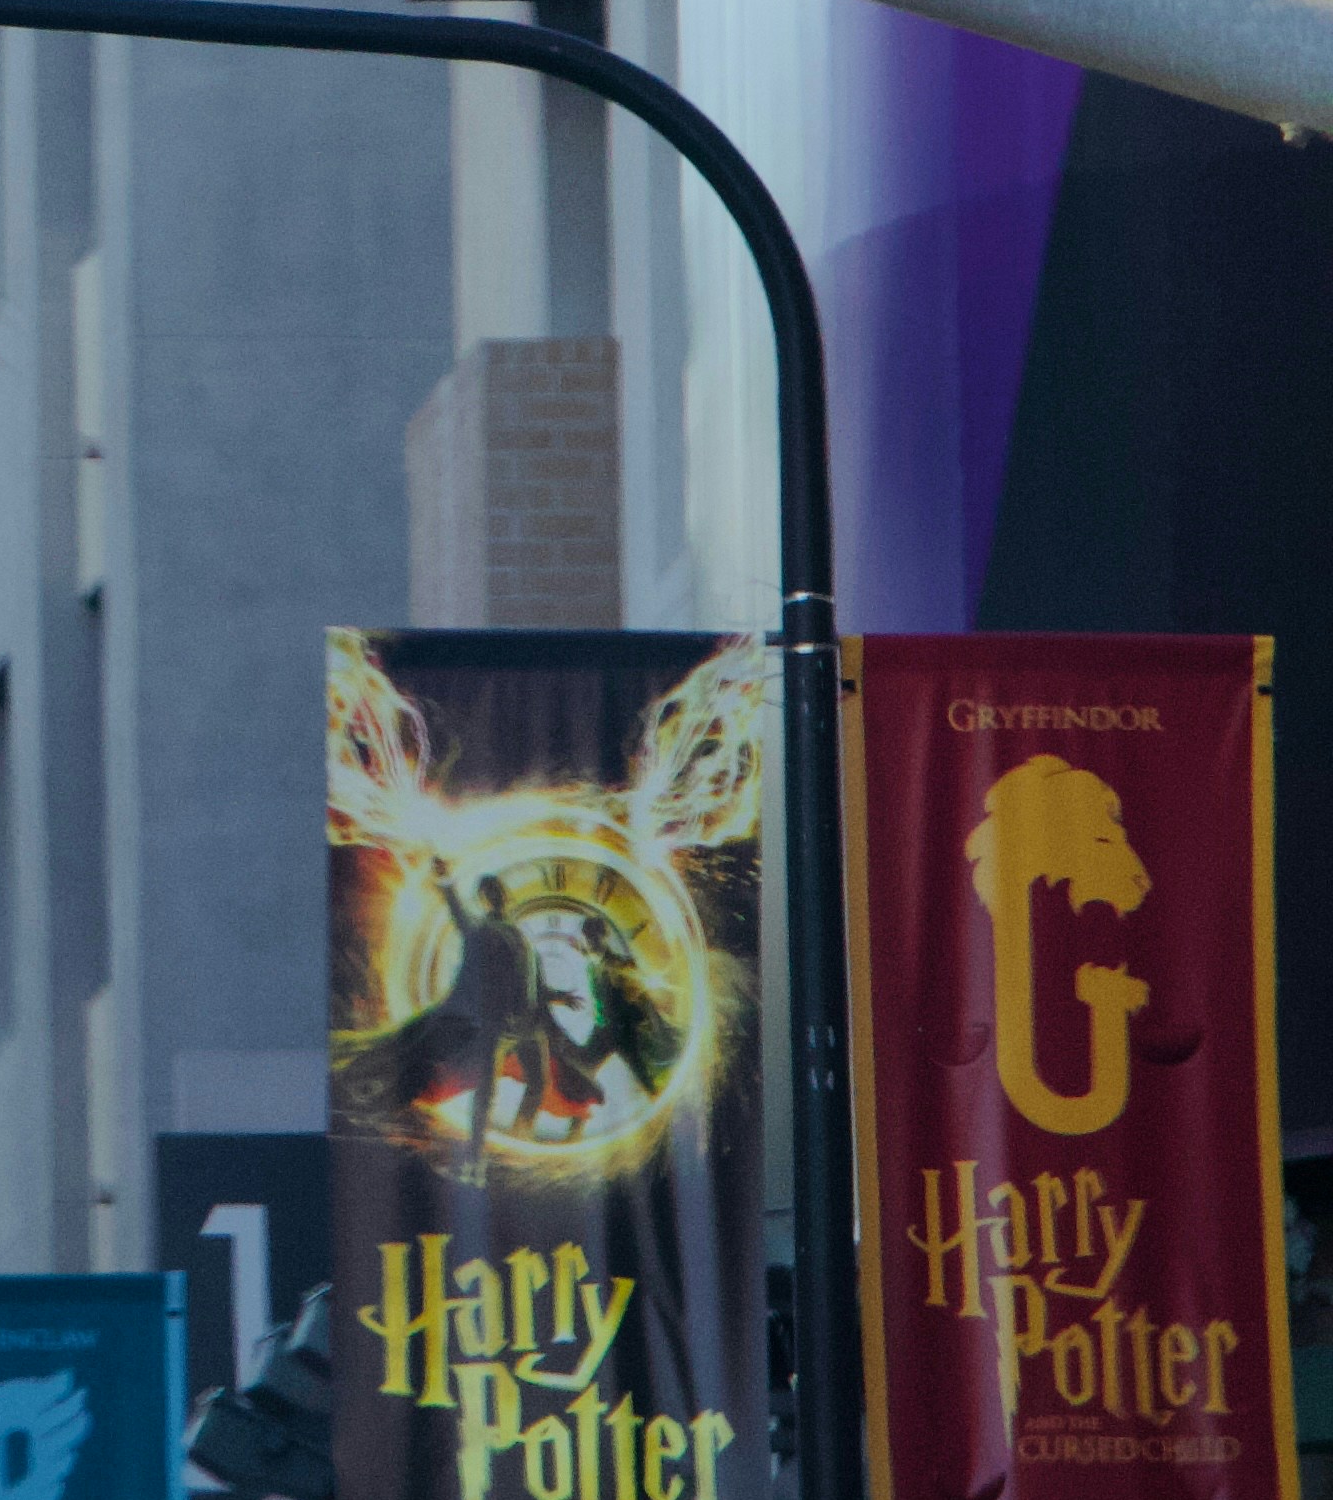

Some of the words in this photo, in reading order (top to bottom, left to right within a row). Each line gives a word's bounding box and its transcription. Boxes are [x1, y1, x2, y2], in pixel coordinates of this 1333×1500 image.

[357, 1233, 635, 1408] Harry
[907, 1159, 1146, 1319] Harry
[987, 1273, 1241, 1448] Potter
